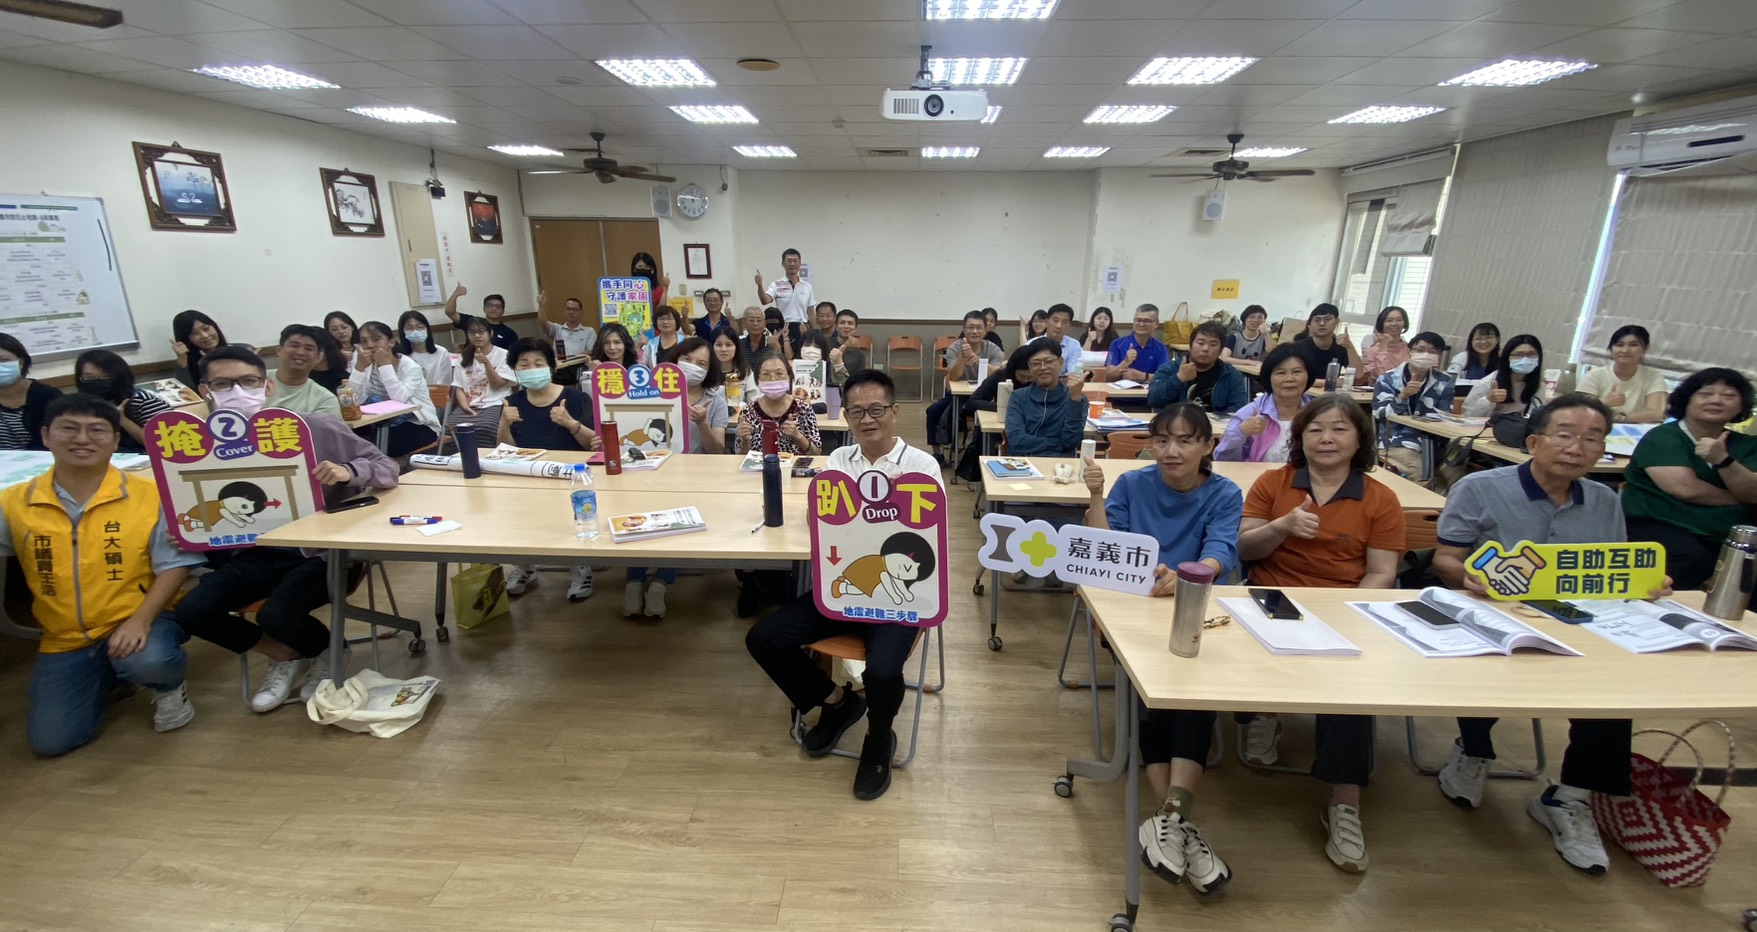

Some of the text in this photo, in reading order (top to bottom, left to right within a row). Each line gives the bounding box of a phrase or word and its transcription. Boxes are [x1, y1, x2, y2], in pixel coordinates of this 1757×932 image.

[602, 280, 644, 289] 攜手同心
[606, 291, 648, 301] 守護家園
[597, 367, 681, 394] 穩 3 住
[154, 417, 302, 458] 掩 2 護
[216, 445, 253, 458] Cover
[816, 479, 857, 517] 趴
[896, 484, 938, 523] 下
[866, 508, 898, 520] Drop
[209, 533, 263, 546] 地震避難
[103, 521, 123, 582] 台大碩士
[1068, 538, 1151, 567] 嘉義市
[1556, 548, 1656, 570] 自助互助
[1066, 564, 1147, 585] CHIAYI CITY
[1556, 573, 1630, 594] 向前行
[844, 606, 918, 622] 地震避難三步驟
